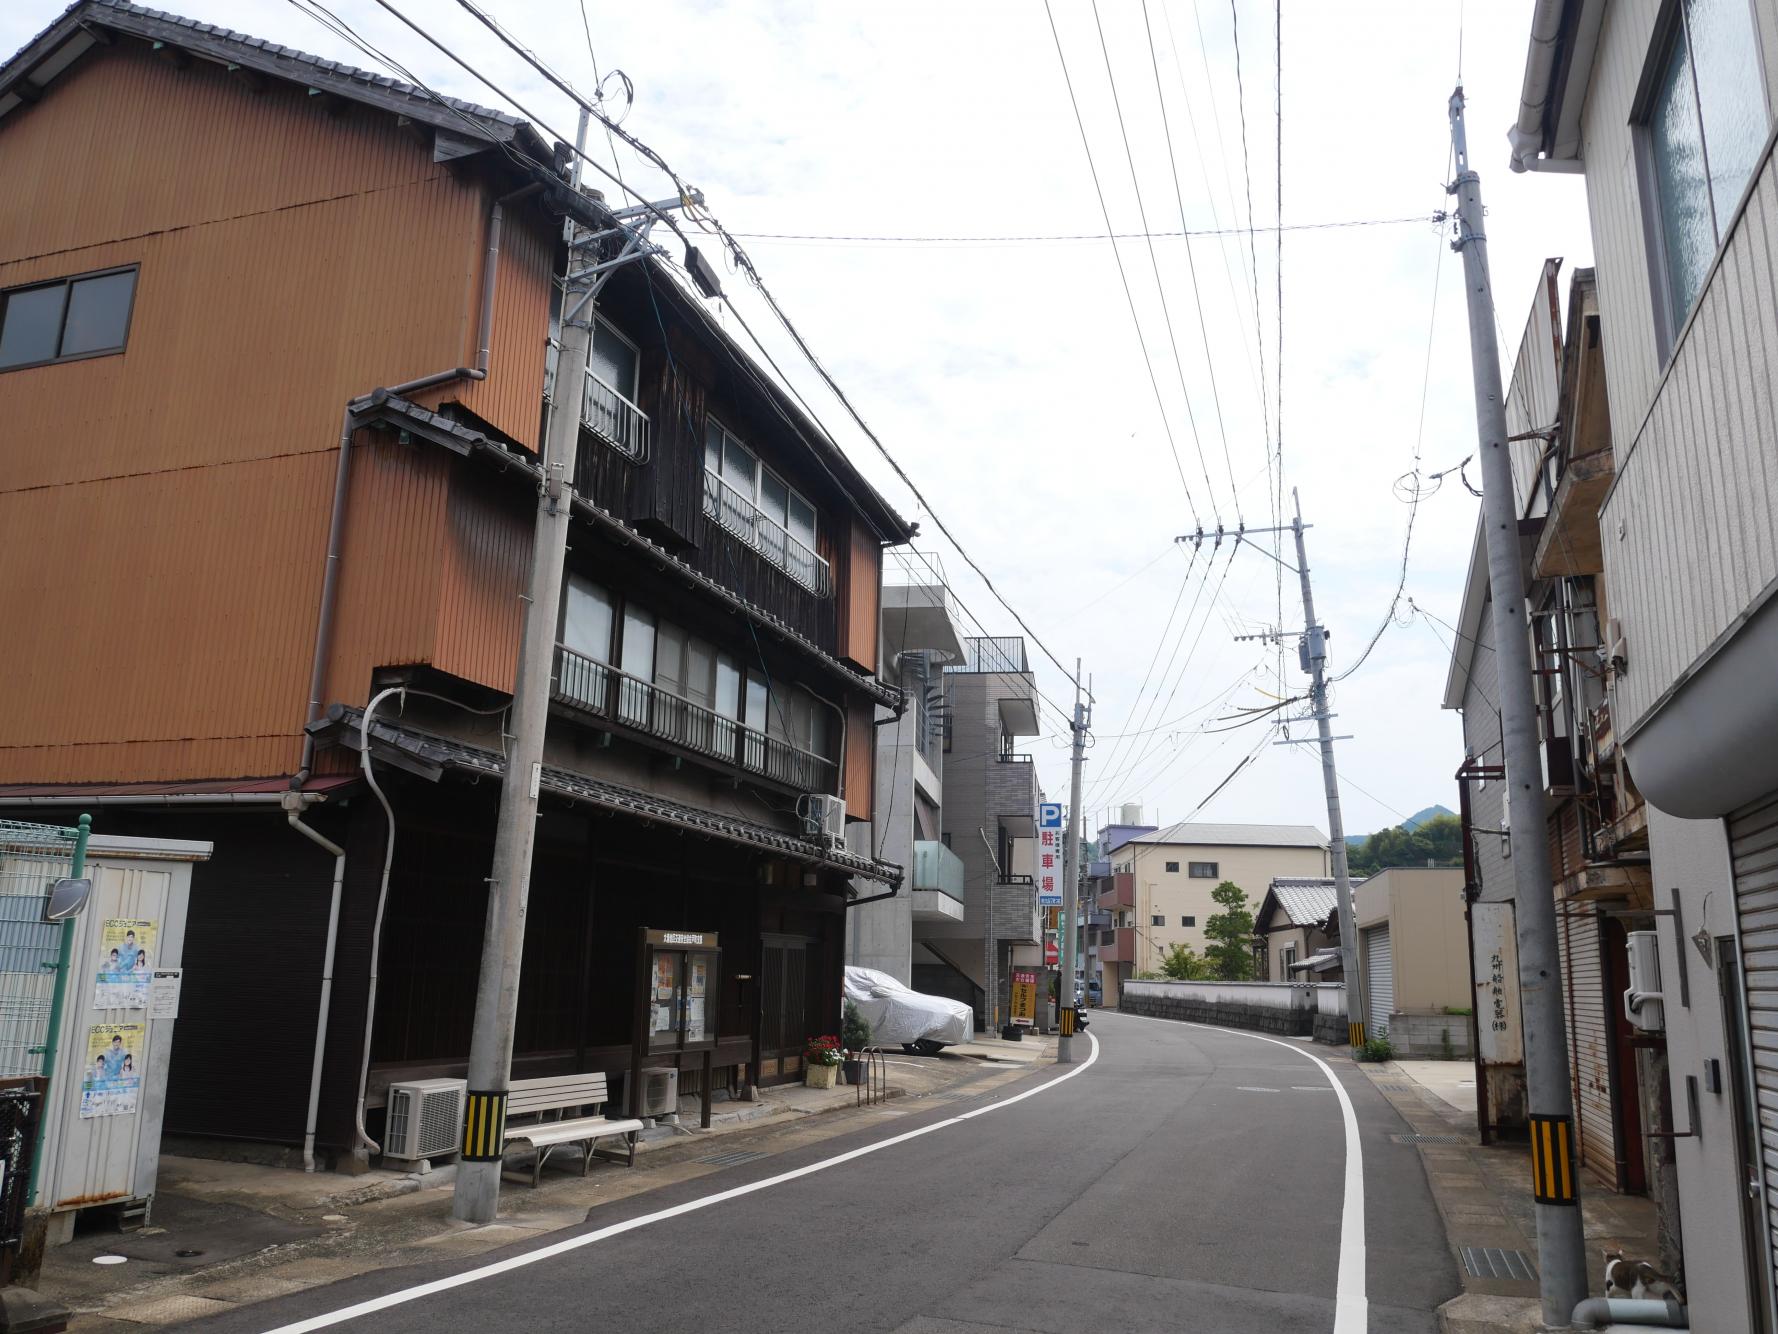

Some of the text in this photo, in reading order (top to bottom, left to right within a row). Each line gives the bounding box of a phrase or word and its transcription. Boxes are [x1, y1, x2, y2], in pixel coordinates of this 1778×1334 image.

[1041, 805, 1060, 826] P
[1042, 831, 1054, 892] 駐車場
